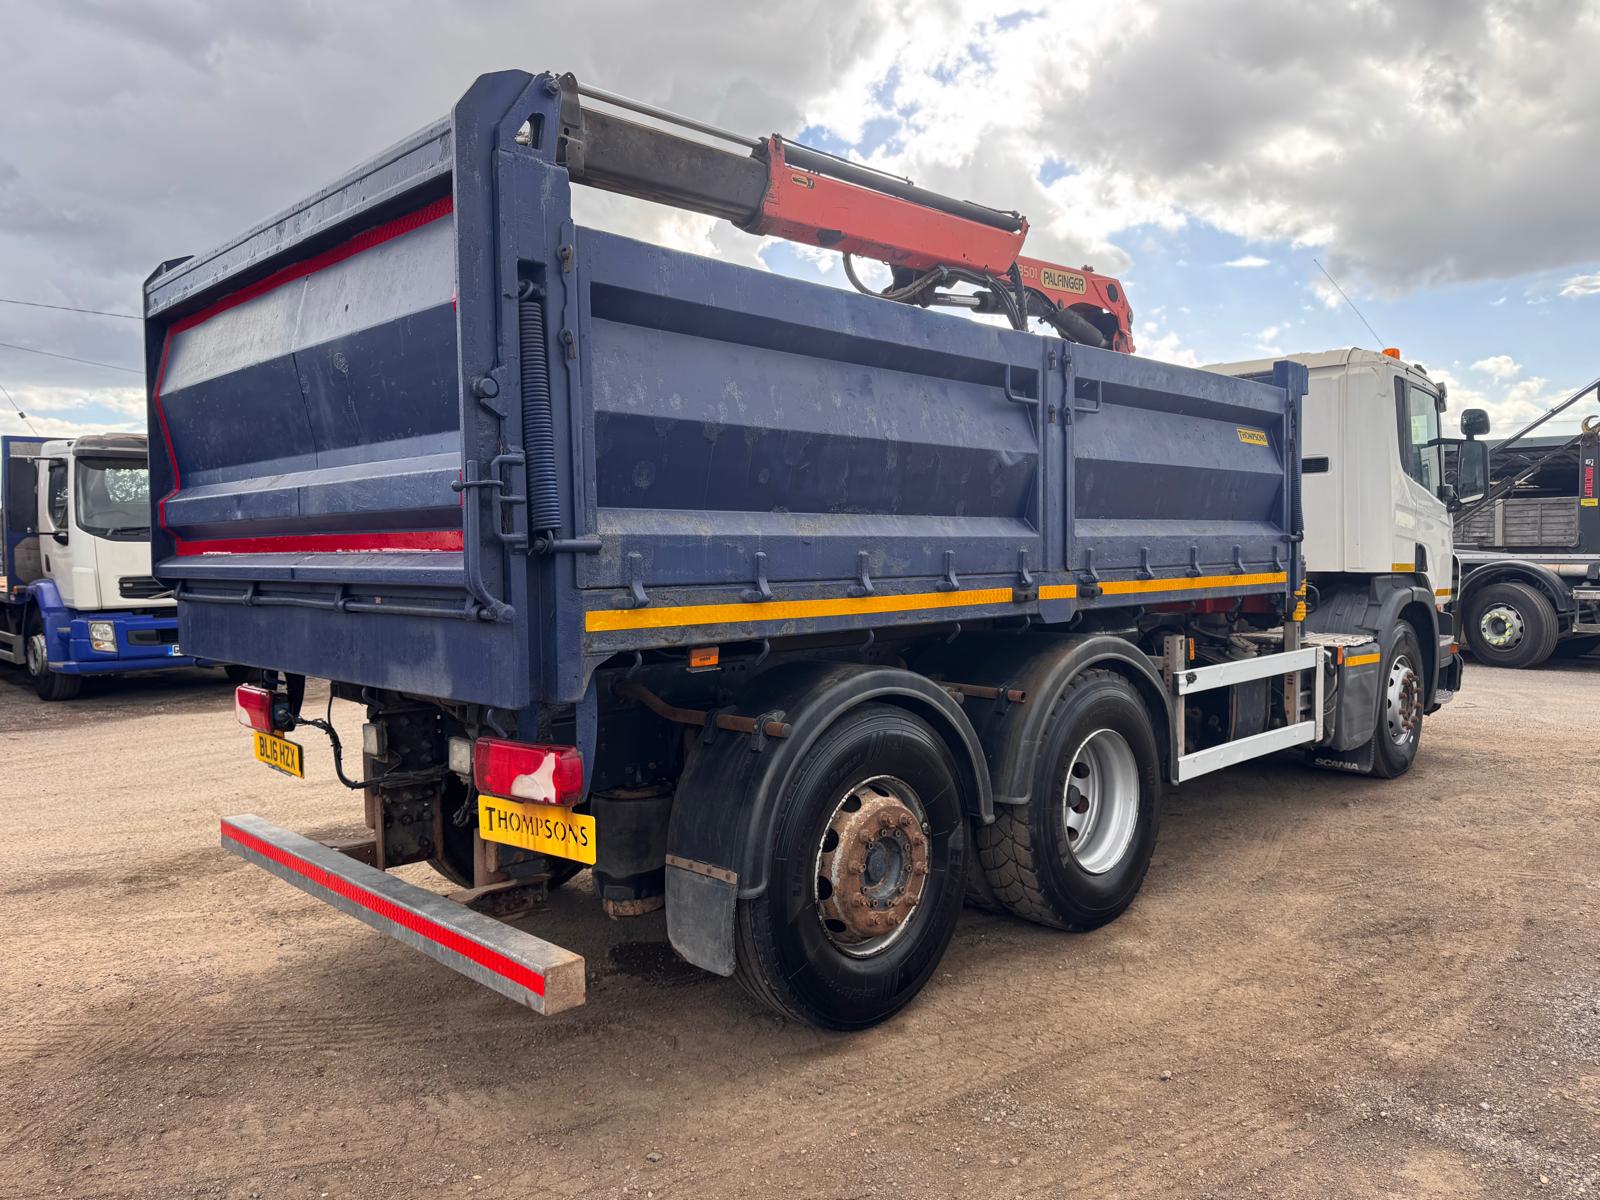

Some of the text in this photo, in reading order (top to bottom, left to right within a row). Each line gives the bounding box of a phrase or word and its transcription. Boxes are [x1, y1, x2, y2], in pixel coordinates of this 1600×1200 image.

[1043, 271, 1084, 291] PALFINGER
[259, 736, 296, 770] BL16 HZX
[1315, 758, 1360, 770] SCANIA
[485, 806, 588, 847] THOMPSONS
